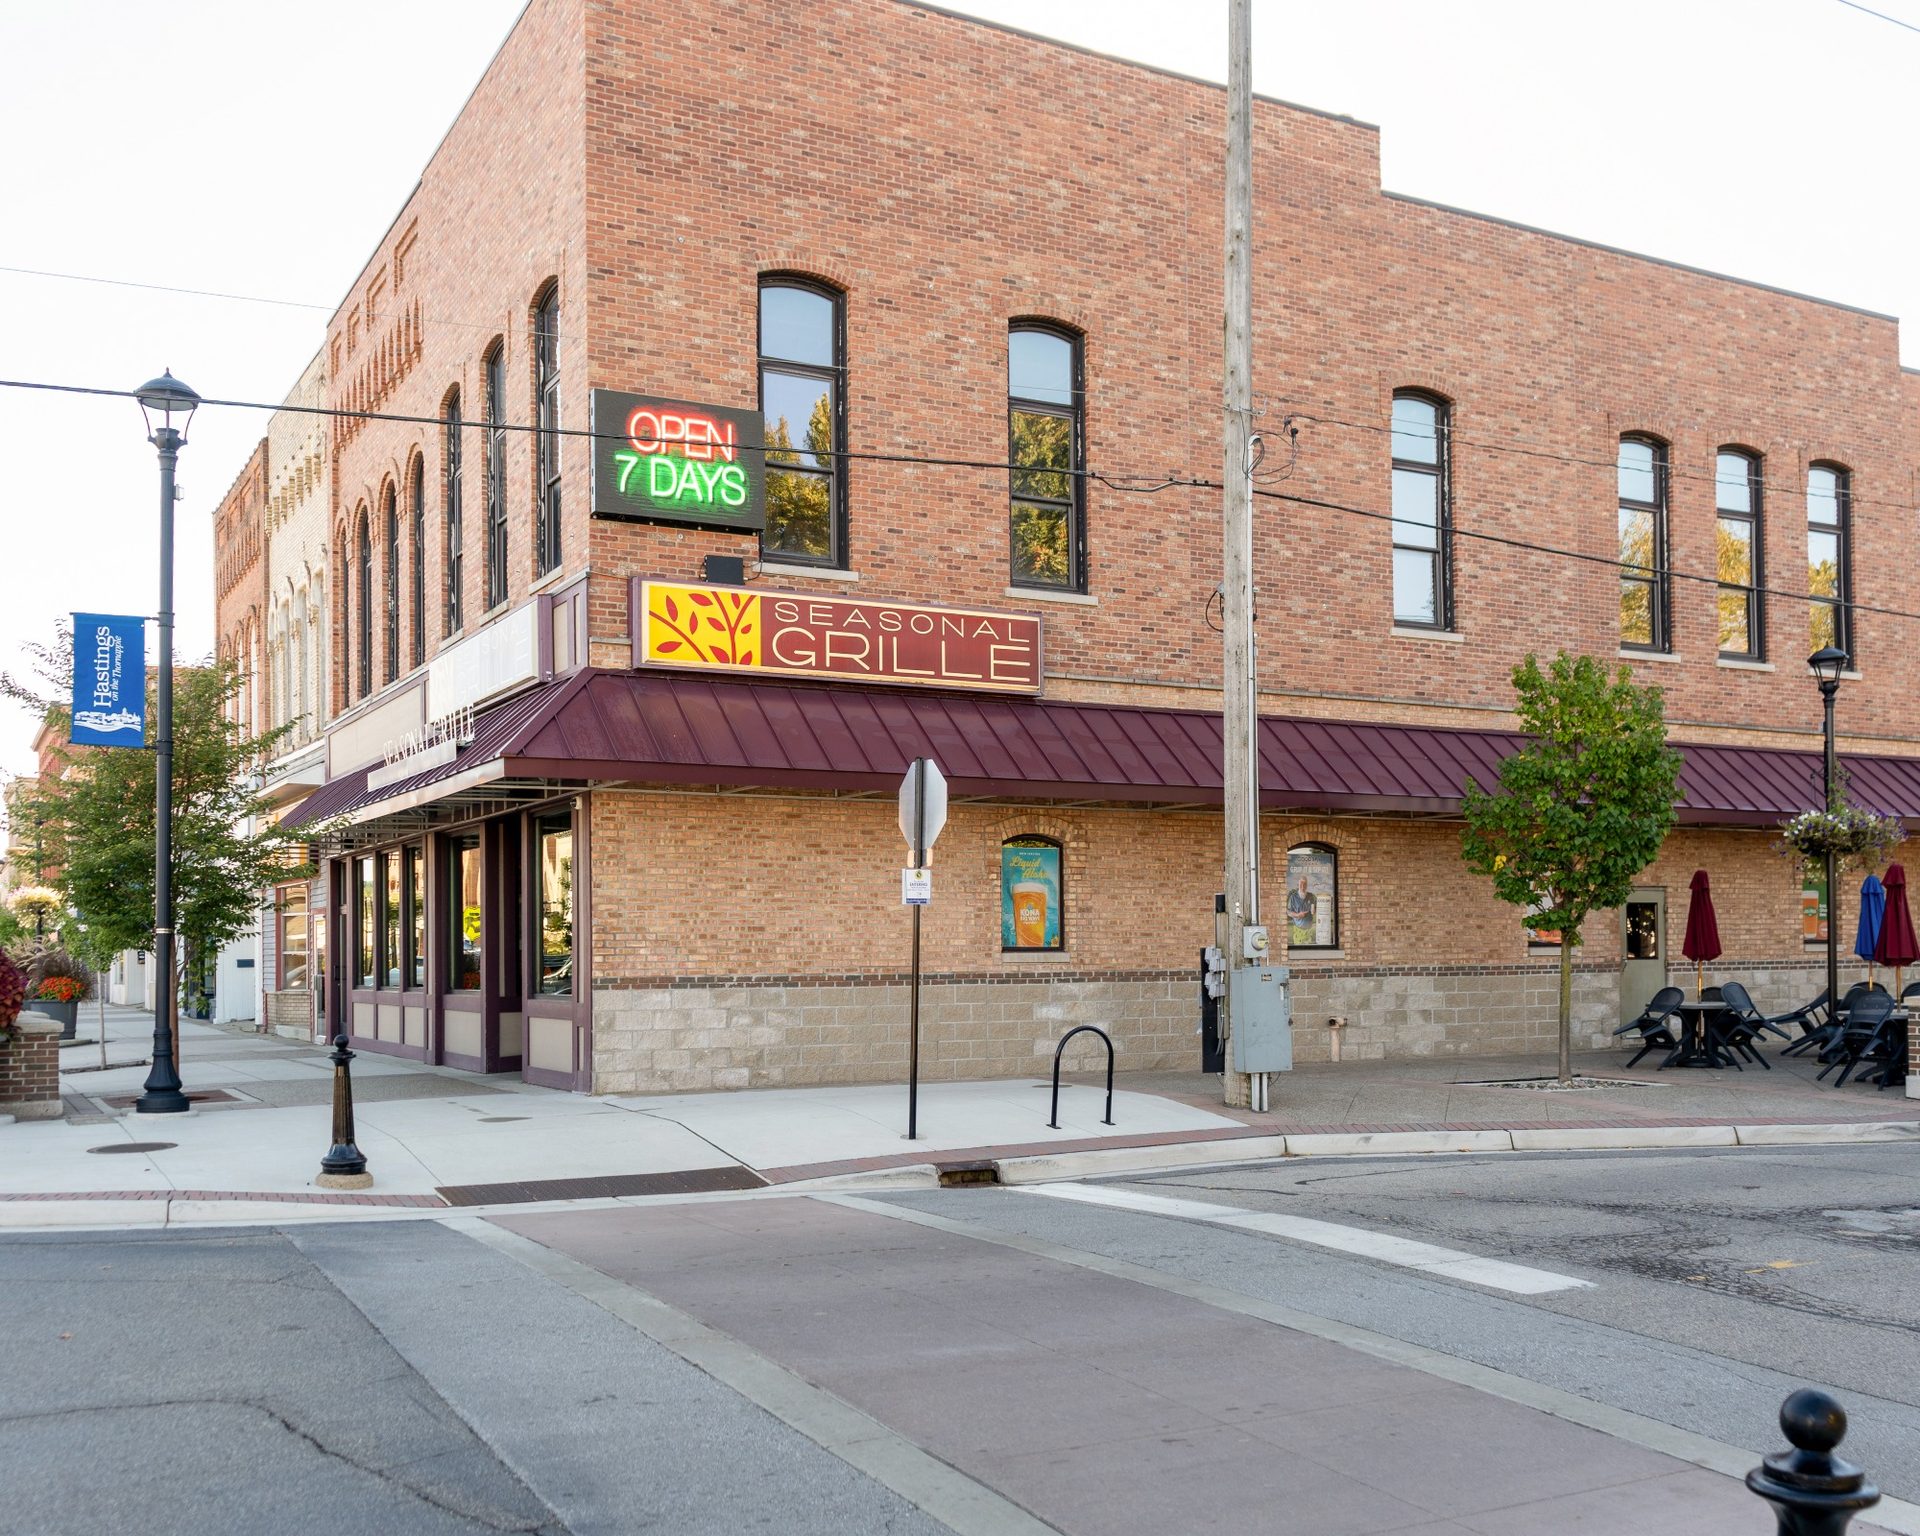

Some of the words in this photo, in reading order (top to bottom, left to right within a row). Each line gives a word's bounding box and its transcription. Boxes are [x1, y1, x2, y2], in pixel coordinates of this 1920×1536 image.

[629, 410, 733, 462] OPEN
[614, 454, 638, 493] 7
[650, 456, 747, 506] DAYS
[773, 600, 1031, 643] SEASONAL
[93, 625, 116, 708] Hastings
[112, 635, 125, 678] Thornapple
[771, 626, 1031, 683] GRILLE
[111, 679, 119, 692] the
[112, 692, 118, 701] on
[433, 703, 476, 747] GRILLE
[1009, 855, 1042, 871] Liquid
